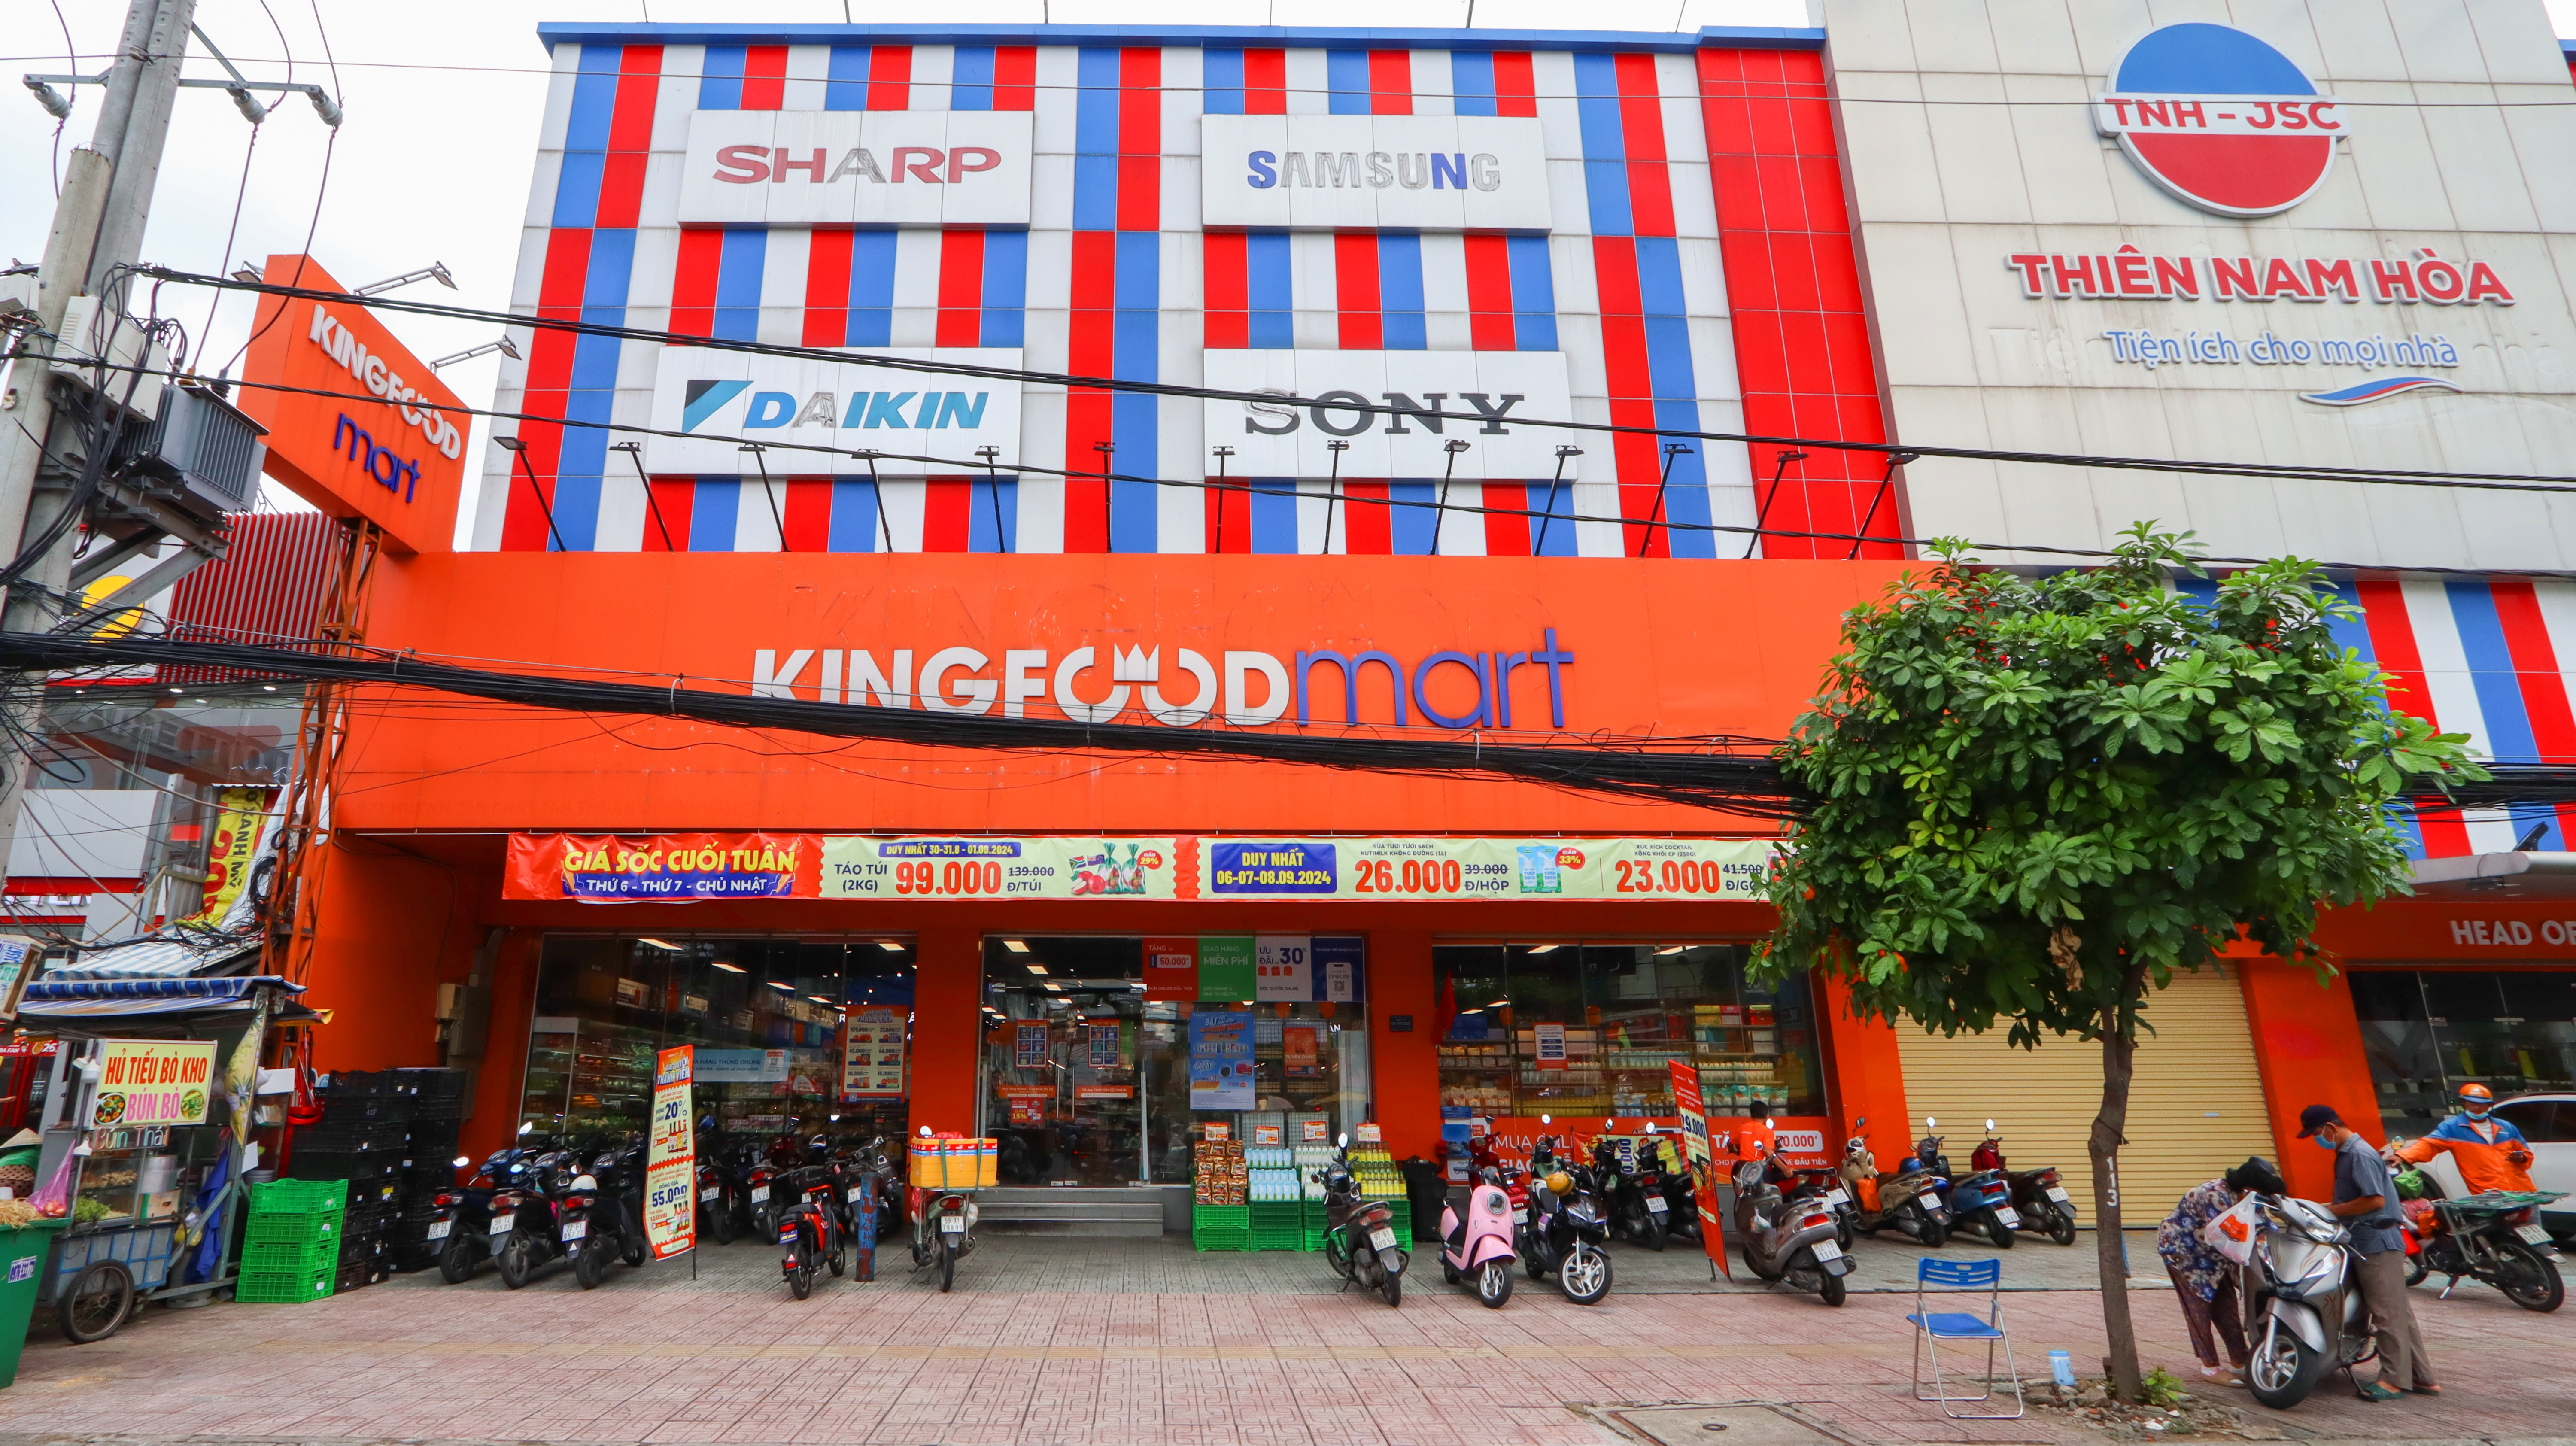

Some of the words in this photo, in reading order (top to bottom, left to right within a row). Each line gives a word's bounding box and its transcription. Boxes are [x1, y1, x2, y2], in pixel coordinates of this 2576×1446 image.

[2104, 98, 2207, 128] TNH
[2245, 101, 2342, 130] JSC
[712, 145, 1002, 184] SHARP
[1247, 150, 1501, 191] SAMSUNG
[2008, 243, 2200, 301] THIÊN
[2208, 257, 2360, 303] NAM
[2368, 247, 2516, 306] HÒA
[2102, 330, 2182, 369] Tiện
[2187, 331, 2239, 364] ích
[2249, 331, 2312, 365] cho
[2319, 334, 2388, 370] mọi
[2390, 333, 2460, 368] nhà
[309, 303, 462, 460] KINGFOOD
[743, 391, 989, 429] DAIKIN
[1242, 387, 1525, 436] SONY
[334, 412, 422, 504] mart
[752, 643, 1290, 727] KINGFOOD
[1297, 628, 1574, 729] mart
[564, 845, 611, 872] GIÁ
[615, 843, 662, 873] SỐC
[667, 841, 726, 872] CUỐI
[732, 841, 796, 872] TUẦN
[886, 844, 904, 856] DUY
[905, 841, 928, 855] NHẤT
[929, 843, 960, 855] 30-31.8
[967, 843, 1014, 856] 01.09.2024
[1242, 852, 1269, 866] DUY
[1271, 848, 1305, 866] NHẤT
[835, 861, 862, 875] TÁO
[865, 861, 887, 875] TÚI
[1559, 855, 1581, 864] 33%
[896, 861, 1002, 895] 99.000
[1007, 866, 1055, 878] 139.000
[1217, 870, 1331, 885] 06-07-08.09.2024
[1355, 860, 1460, 893] 26.000
[1464, 864, 1508, 875] 39.000
[1615, 860, 1720, 893] 23.000
[1722, 864, 1762, 874] 41.500
[586, 877, 620, 893] THỨ
[620, 880, 629, 892] 6
[641, 876, 674, 893] THỨ
[674, 880, 683, 892] 7
[696, 876, 727, 892] CHỦ
[731, 876, 768, 894] NHẬT
[842, 880, 878, 893] (2KG)
[1007, 879, 1042, 893] Đ/TÚI
[1464, 879, 1509, 895] Đ/HỘP
[2450, 920, 2533, 946] HEAD
[1204, 953, 1229, 965] MIỄN
[1231, 954, 1249, 966] PHÍ
[105, 1048, 126, 1085] HỦ
[128, 1048, 159, 1084] TIẾU
[159, 1051, 179, 1084] BÒ
[180, 1057, 207, 1084] KHO
[676, 1066, 690, 1082] VIÊN
[126, 1087, 158, 1121] BÚN
[160, 1087, 180, 1120] BÒ
[96, 1127, 128, 1150] Bún
[134, 1123, 170, 1147] Thái
[1495, 1135, 1536, 1149] MUA
[1795, 1157, 1810, 1166] ĐẦU
[1812, 1157, 1827, 1166] TIÊN
[652, 1184, 688, 1207] 55.000
[431, 1222, 448, 1231] 59-T2
[495, 1216, 510, 1226] 59-T2
[567, 1223, 582, 1233] 72-F1
[1374, 1230, 1391, 1240] 97-B1
[1820, 1249, 1838, 1260] 1186
